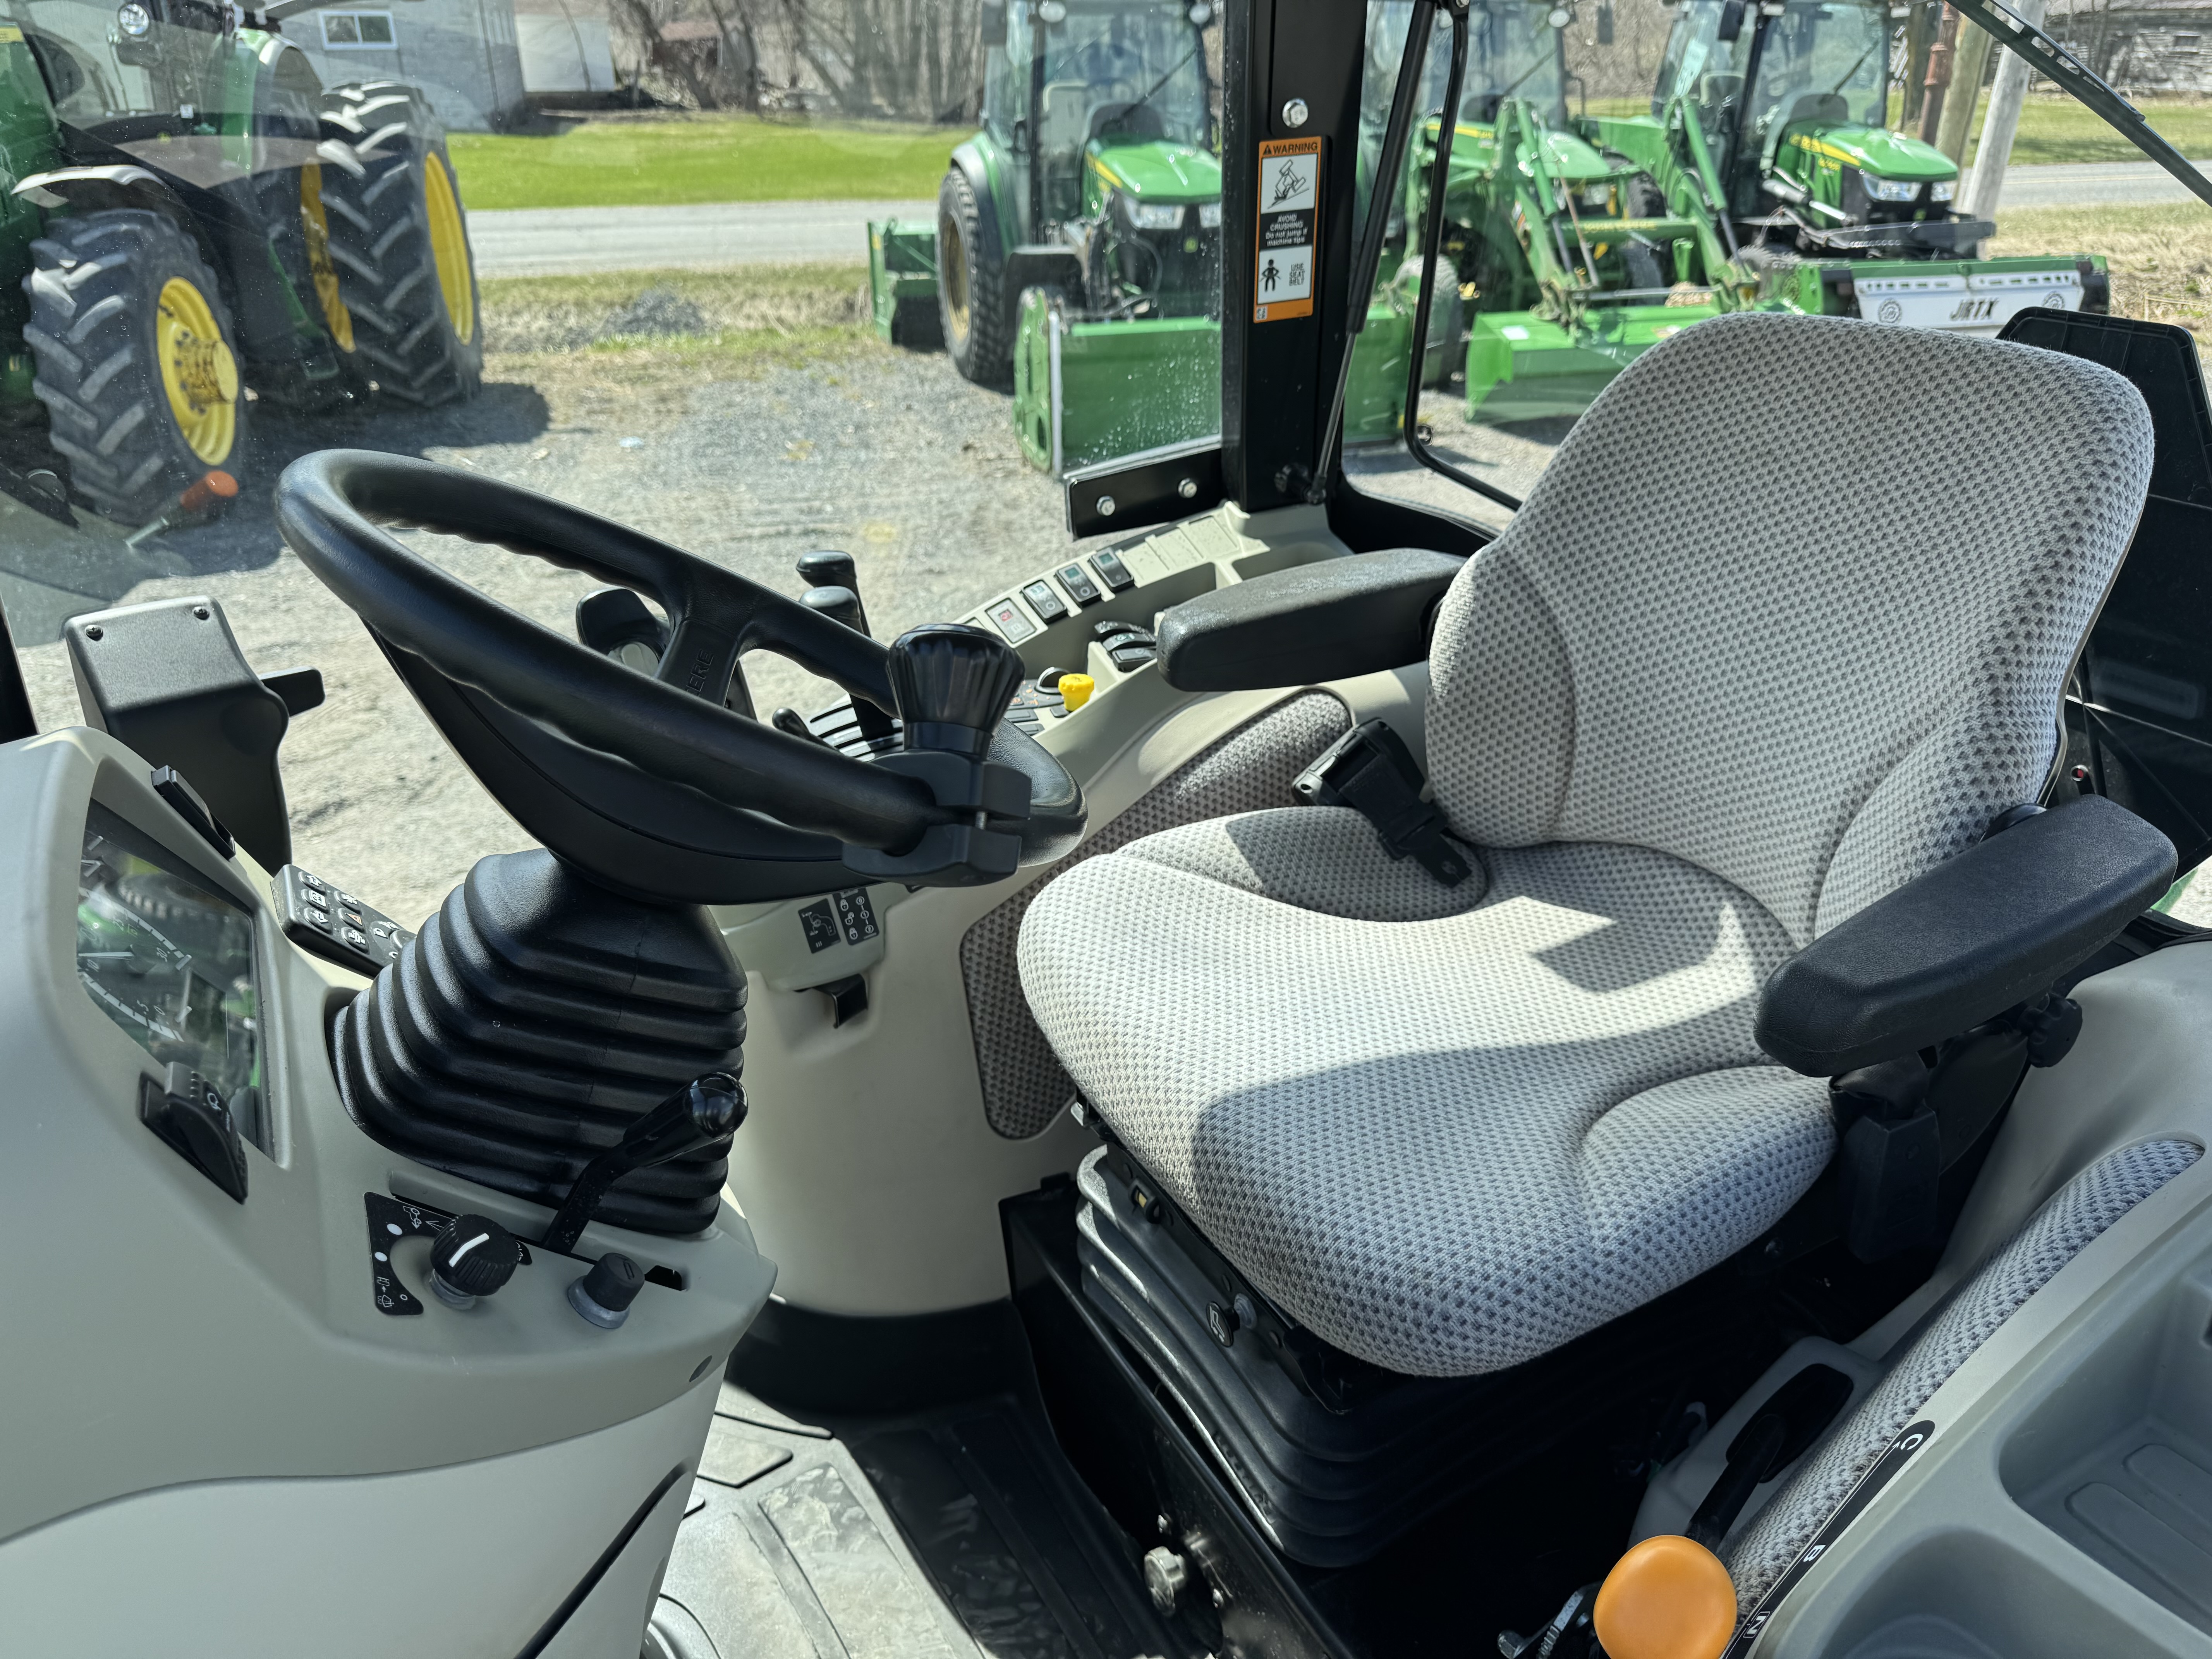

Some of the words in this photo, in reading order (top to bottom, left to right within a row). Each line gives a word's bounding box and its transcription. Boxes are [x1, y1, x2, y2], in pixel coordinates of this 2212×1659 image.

[1272, 142, 1317, 154] WARNING
[1277, 213, 1297, 223] AVOID
[1270, 221, 1304, 232] CRUSHING
[1900, 1433, 1923, 1450] C
[1803, 1544, 1826, 1563] B
[1746, 1615, 1767, 1635] N
